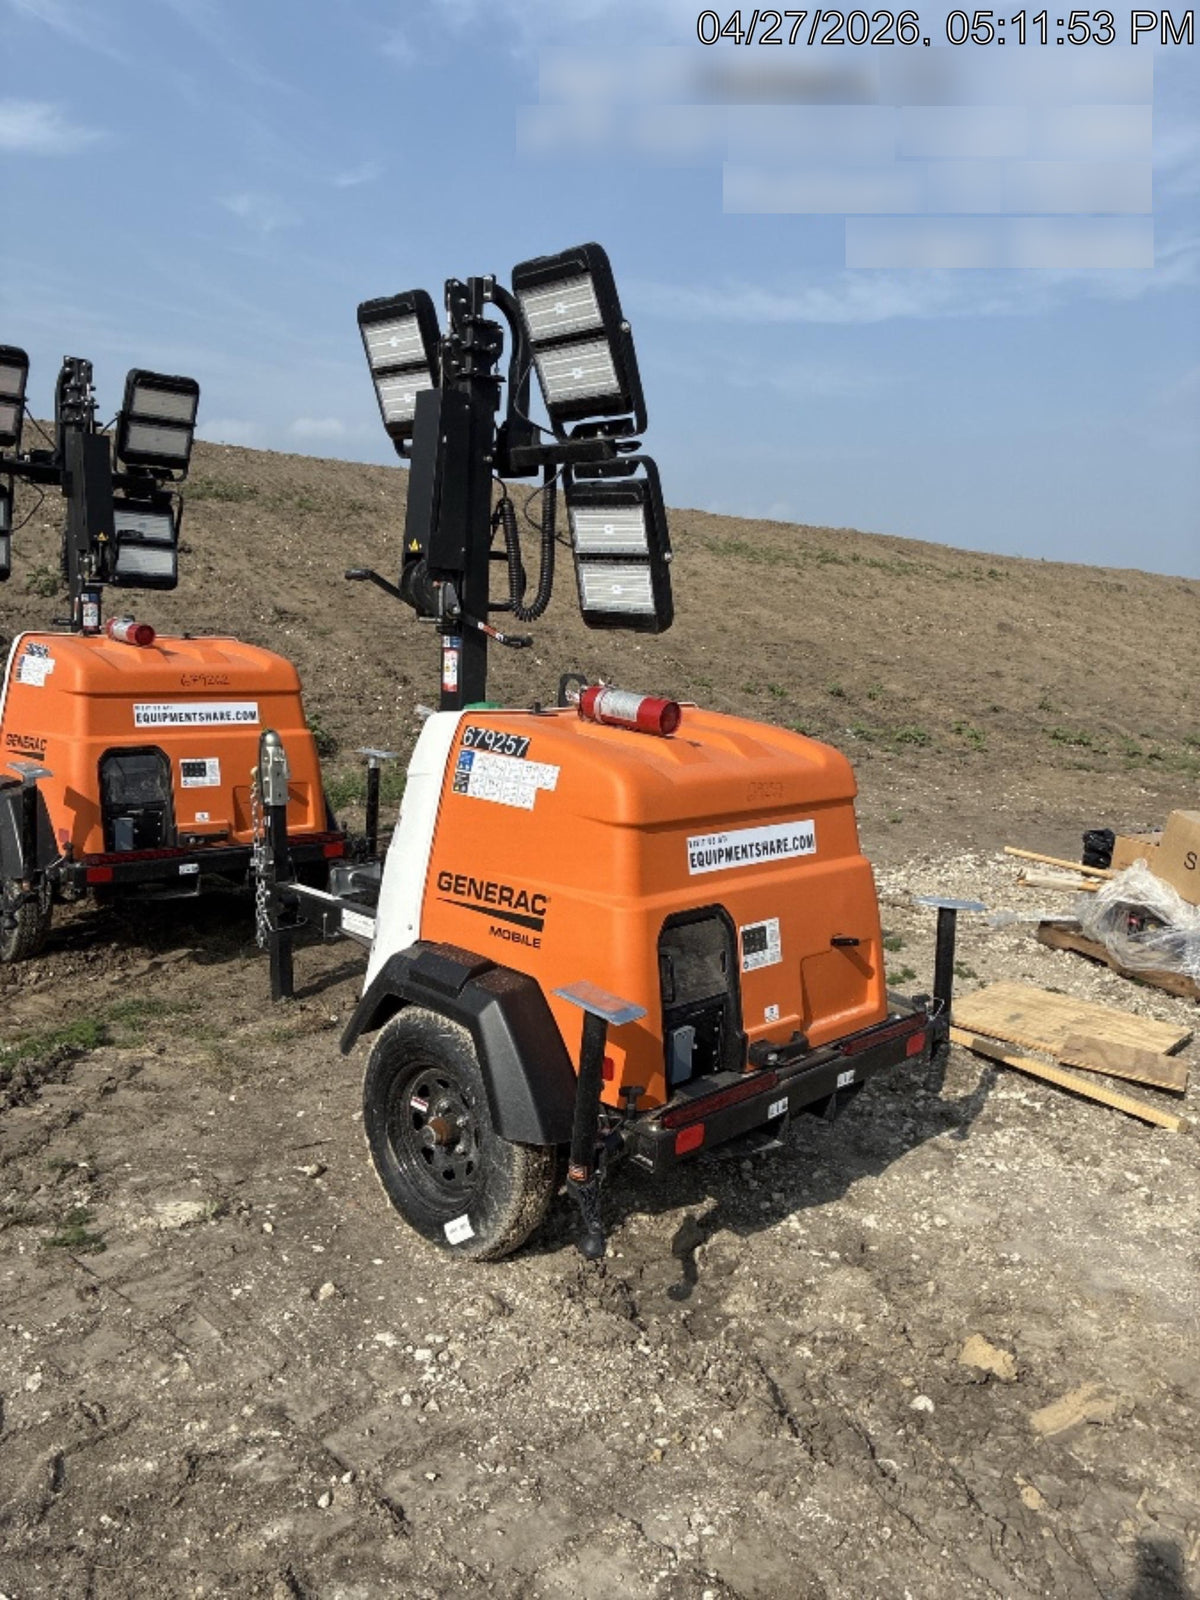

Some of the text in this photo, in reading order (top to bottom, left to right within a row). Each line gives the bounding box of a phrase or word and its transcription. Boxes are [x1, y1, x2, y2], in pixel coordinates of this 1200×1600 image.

[136, 710, 257, 724] EQUIPMENTSHARE.COM
[6, 733, 47, 751] GENERAC
[463, 726, 530, 757] 679257
[689, 833, 814, 868] EQUIPMENTSHARE.COM
[437, 870, 548, 917] GENERAC
[489, 925, 542, 949] MOBILE
